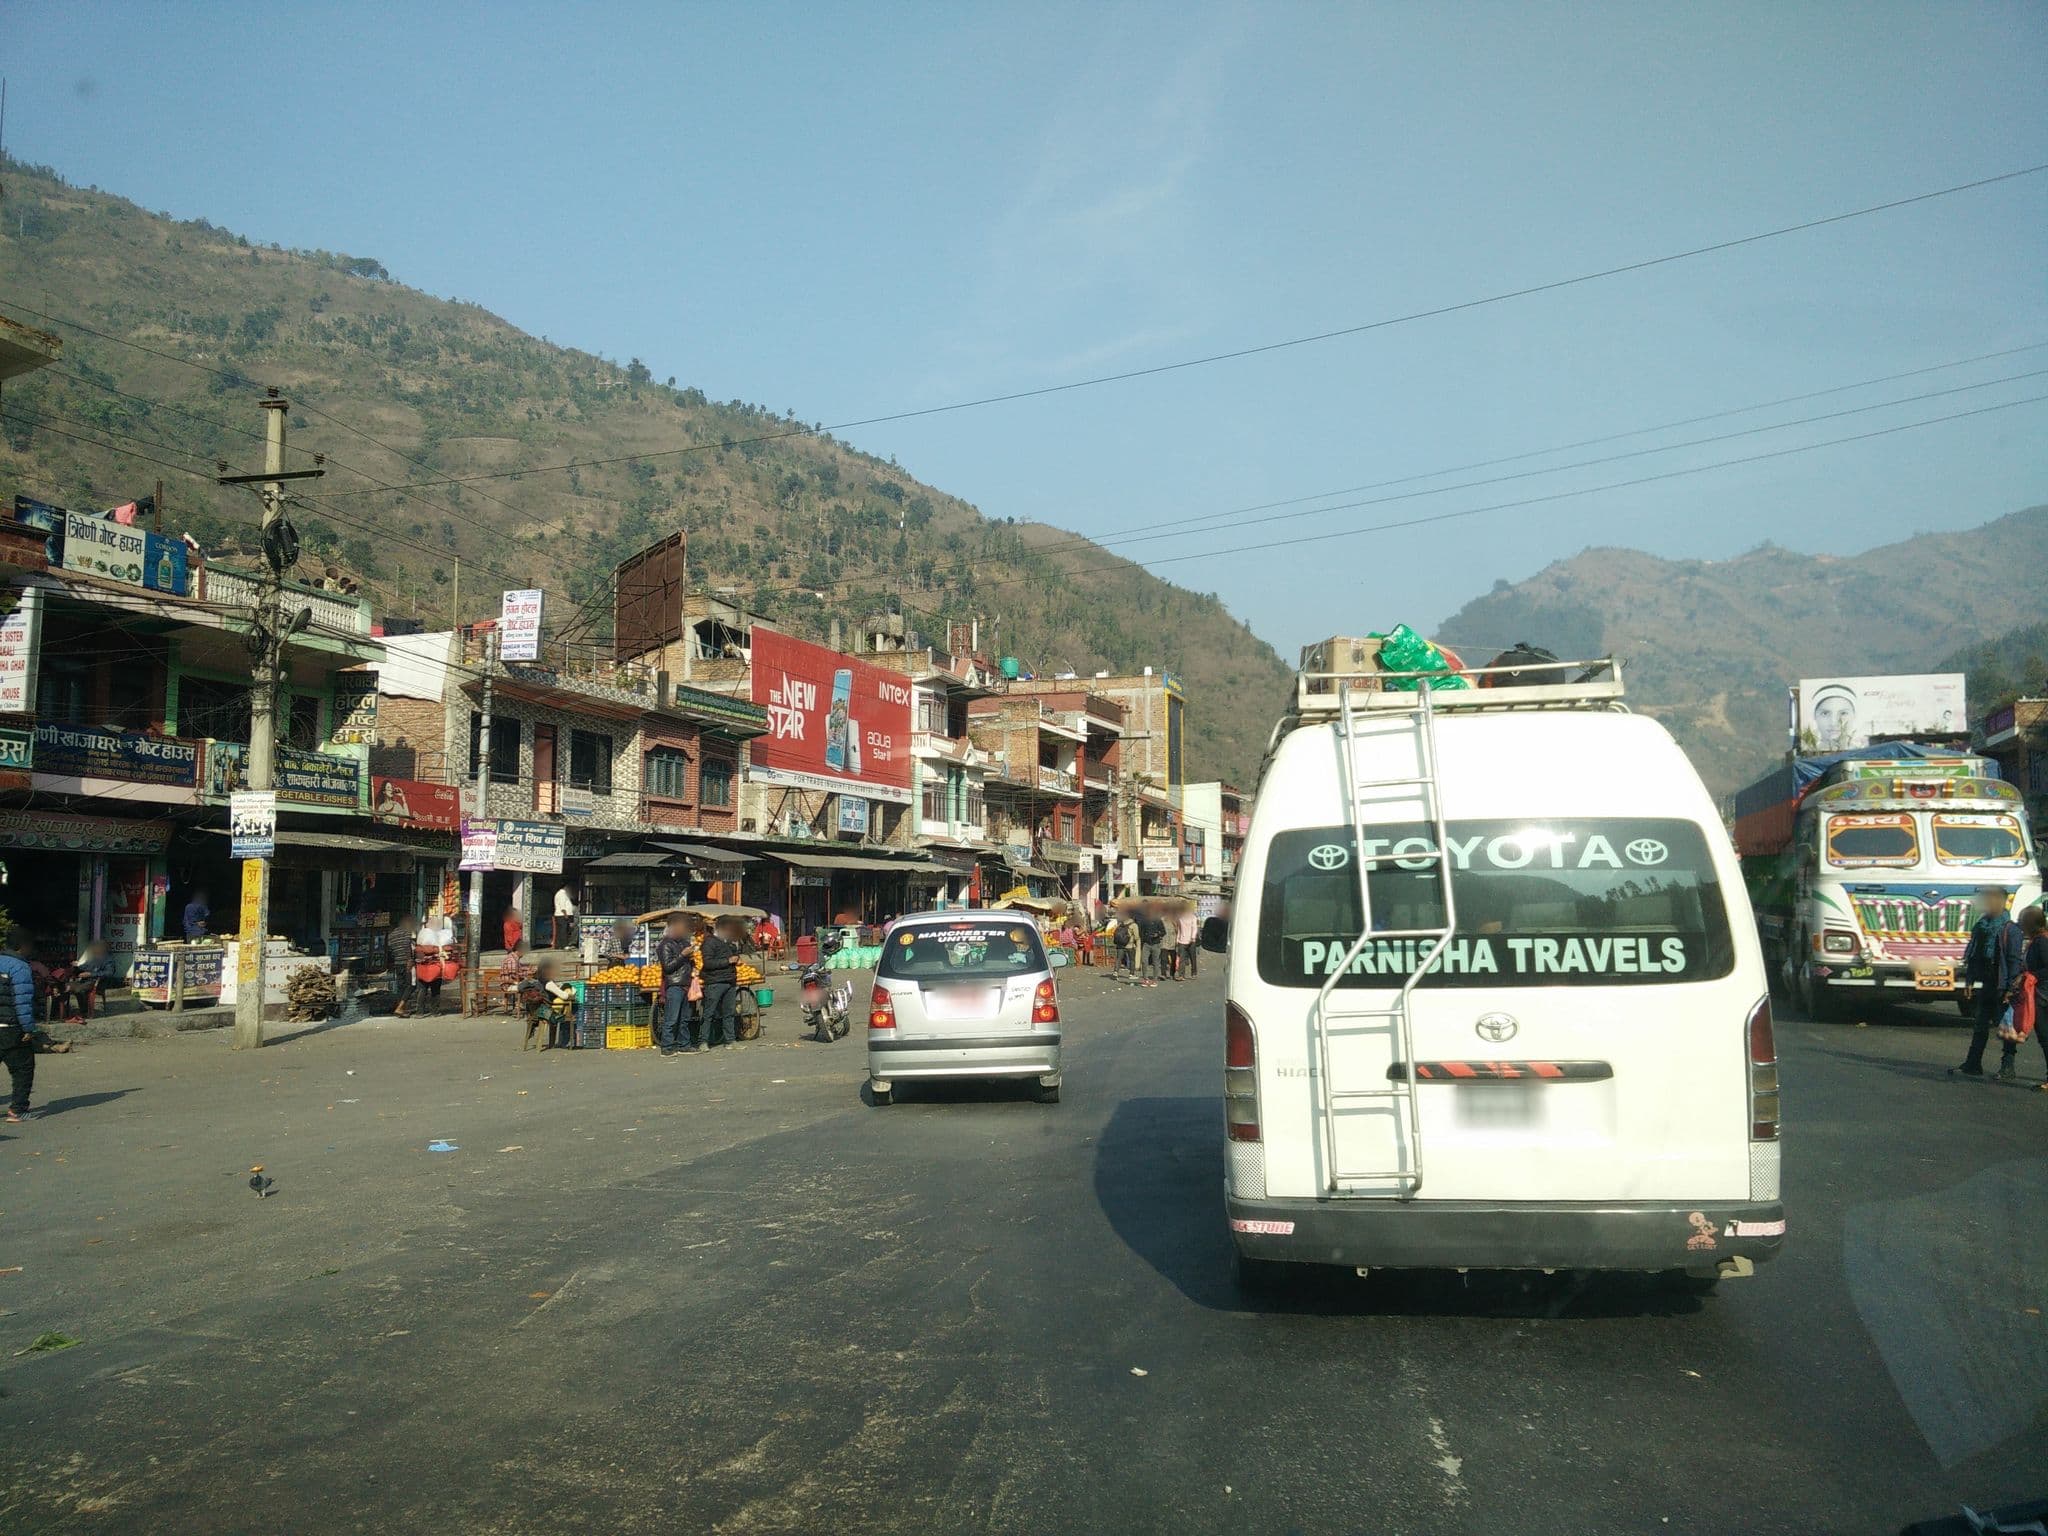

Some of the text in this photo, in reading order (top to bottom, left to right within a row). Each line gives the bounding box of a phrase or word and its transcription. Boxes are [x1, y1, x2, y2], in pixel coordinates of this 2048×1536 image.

[4, 631, 24, 642] SISTER
[2, 687, 21, 699] HOUSE
[769, 689, 783, 704] THE
[782, 671, 816, 712] NEW
[767, 704, 805, 740] STAR
[59, 731, 96, 749] खाजा
[135, 737, 161, 756] गेष्ट
[162, 744, 195, 762] हाउस
[275, 790, 322, 802] EGETABLE
[498, 831, 523, 844] होटल
[1351, 834, 1625, 872] TOYOTA
[500, 855, 523, 867] गेष्ट
[524, 858, 554, 870] हाउस
[918, 930, 1006, 940] MANCHESTER
[1303, 937, 1687, 976] PARNISHA TRAVELS
